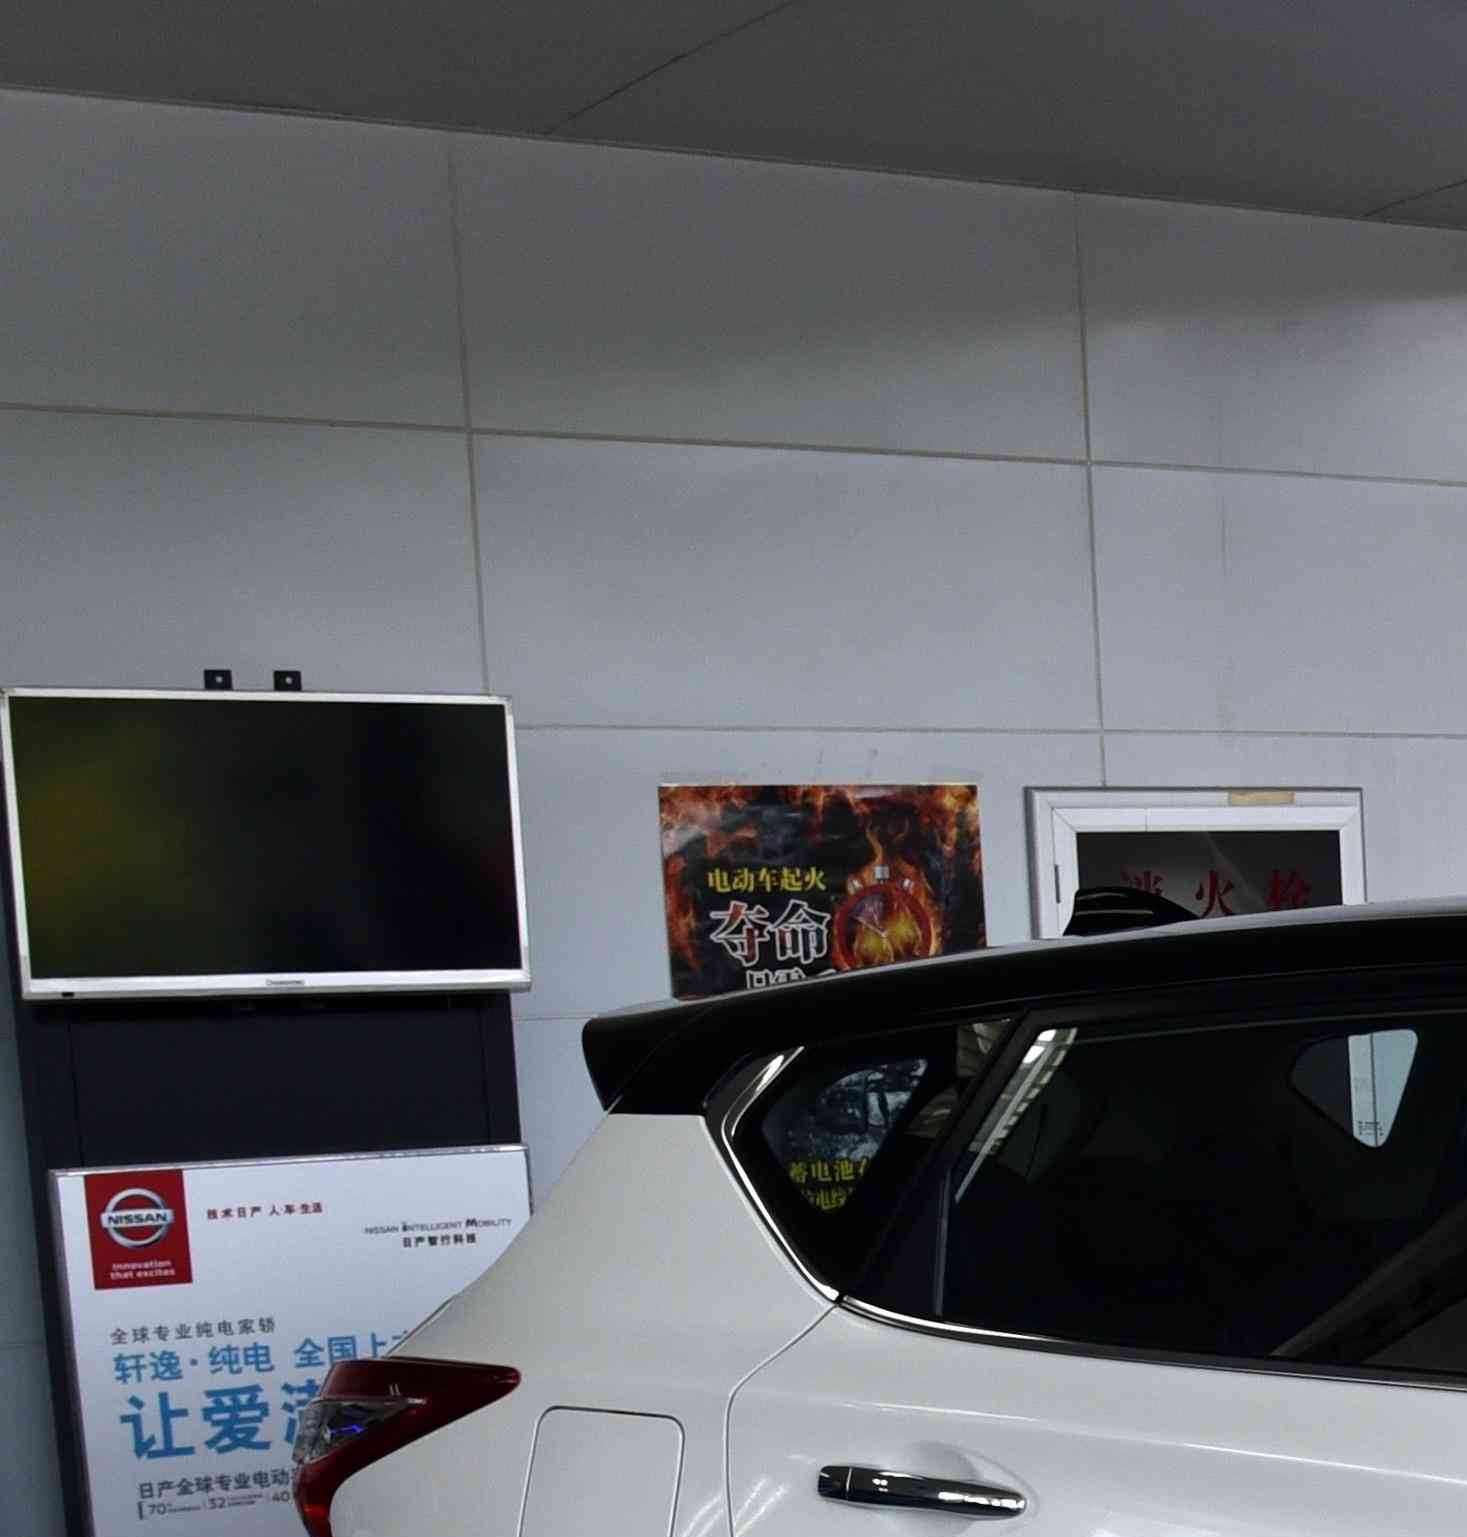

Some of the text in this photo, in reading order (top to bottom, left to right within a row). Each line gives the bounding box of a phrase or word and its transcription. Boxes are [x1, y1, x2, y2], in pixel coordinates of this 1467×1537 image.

[708, 866, 827, 893] 电动车起火
[709, 899, 832, 967] 夺命
[107, 1211, 168, 1225] NISSAN
[110, 1316, 277, 1345] 全球专业纯电家轿
[294, 1330, 409, 1369] 全国上
